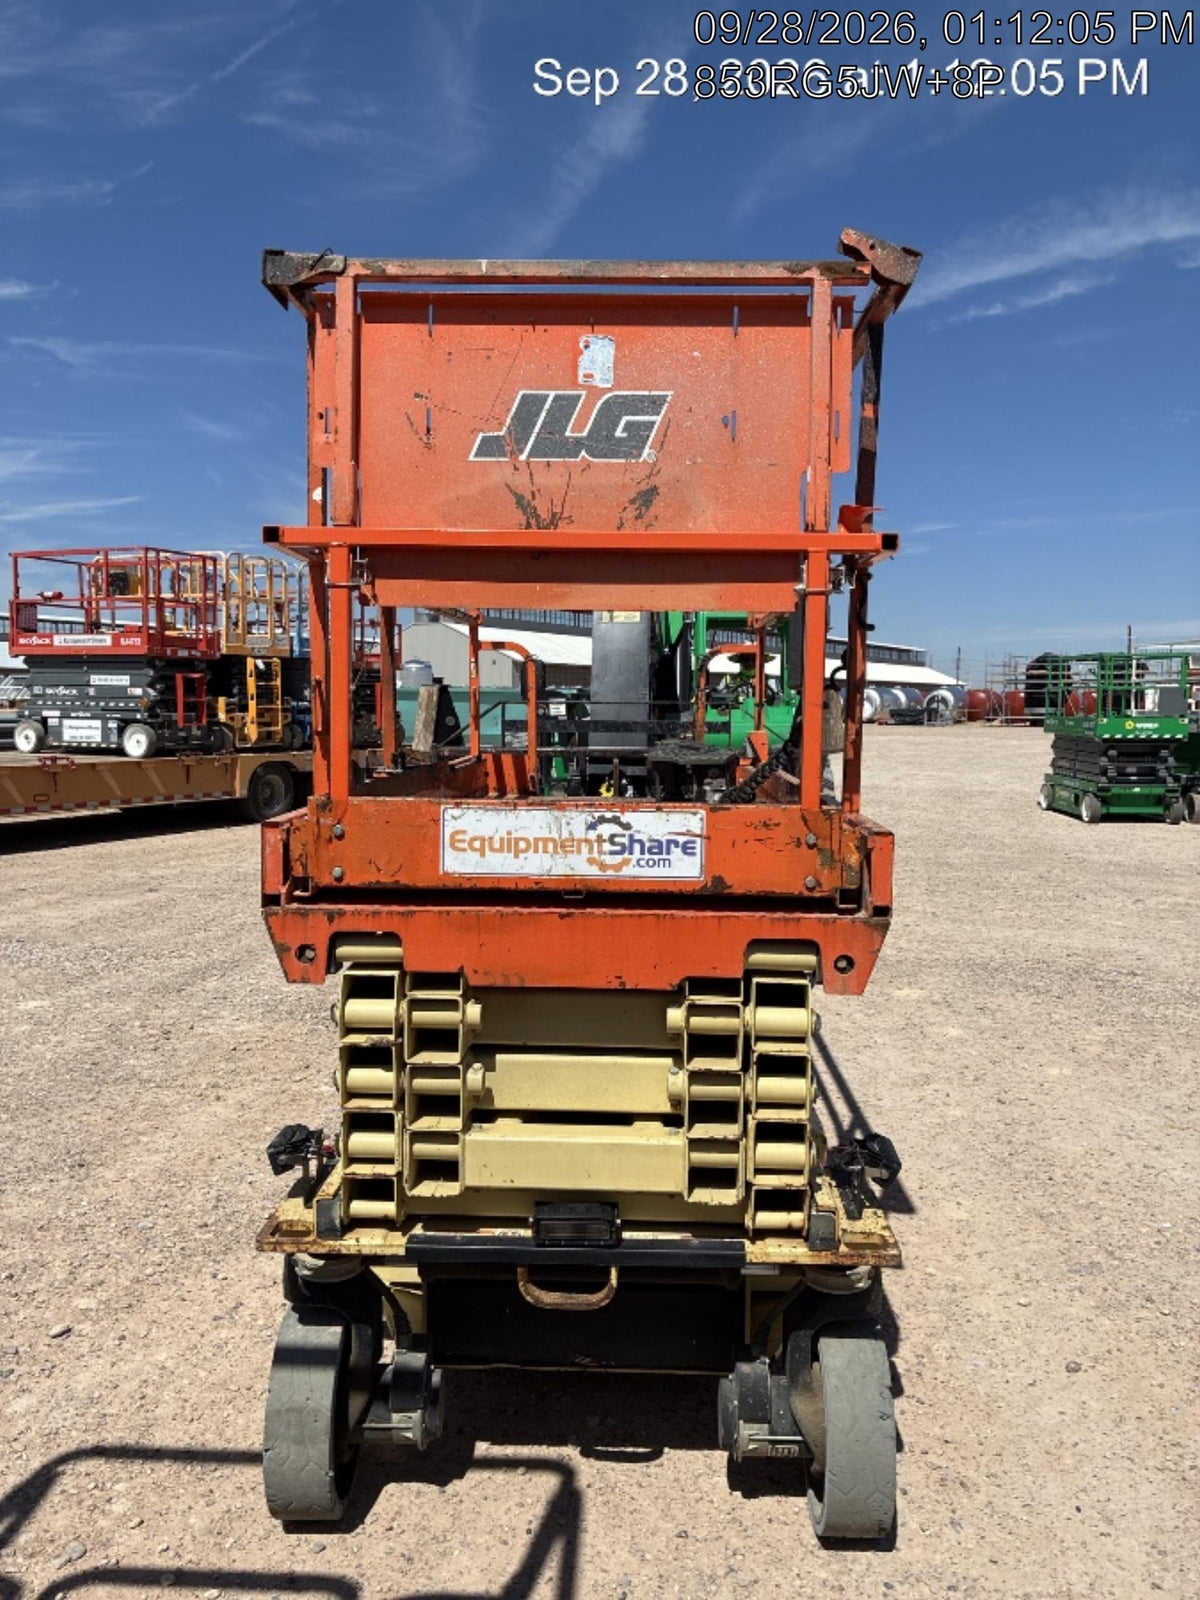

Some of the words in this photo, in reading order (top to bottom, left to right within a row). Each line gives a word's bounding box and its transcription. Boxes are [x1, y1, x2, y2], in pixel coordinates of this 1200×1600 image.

[468, 390, 674, 463] JLG
[449, 828, 698, 859] EquipmentShare
[632, 856, 671, 868] .com
